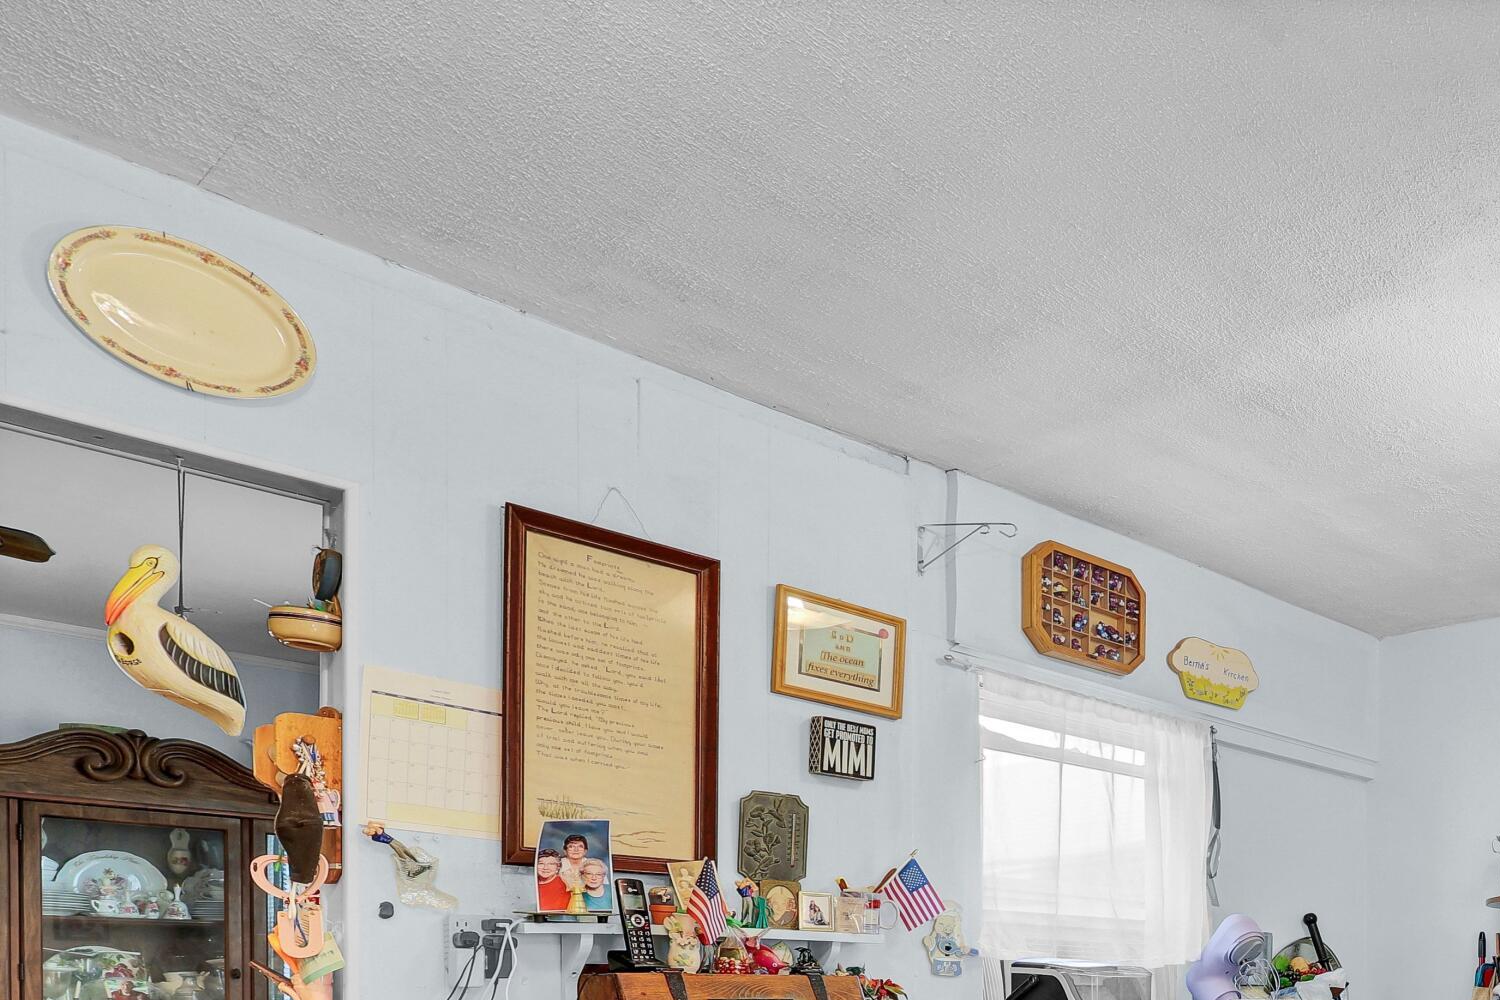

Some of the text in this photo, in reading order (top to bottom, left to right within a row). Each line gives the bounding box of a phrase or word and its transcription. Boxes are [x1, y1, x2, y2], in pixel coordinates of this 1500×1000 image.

[839, 654, 864, 667] ocean
[807, 661, 875, 688] fixes everything
[823, 727, 874, 745] GET PROMOTED TO
[837, 721, 847, 731] THE
[846, 723, 859, 733] BEST
[823, 737, 873, 778] MIMI
